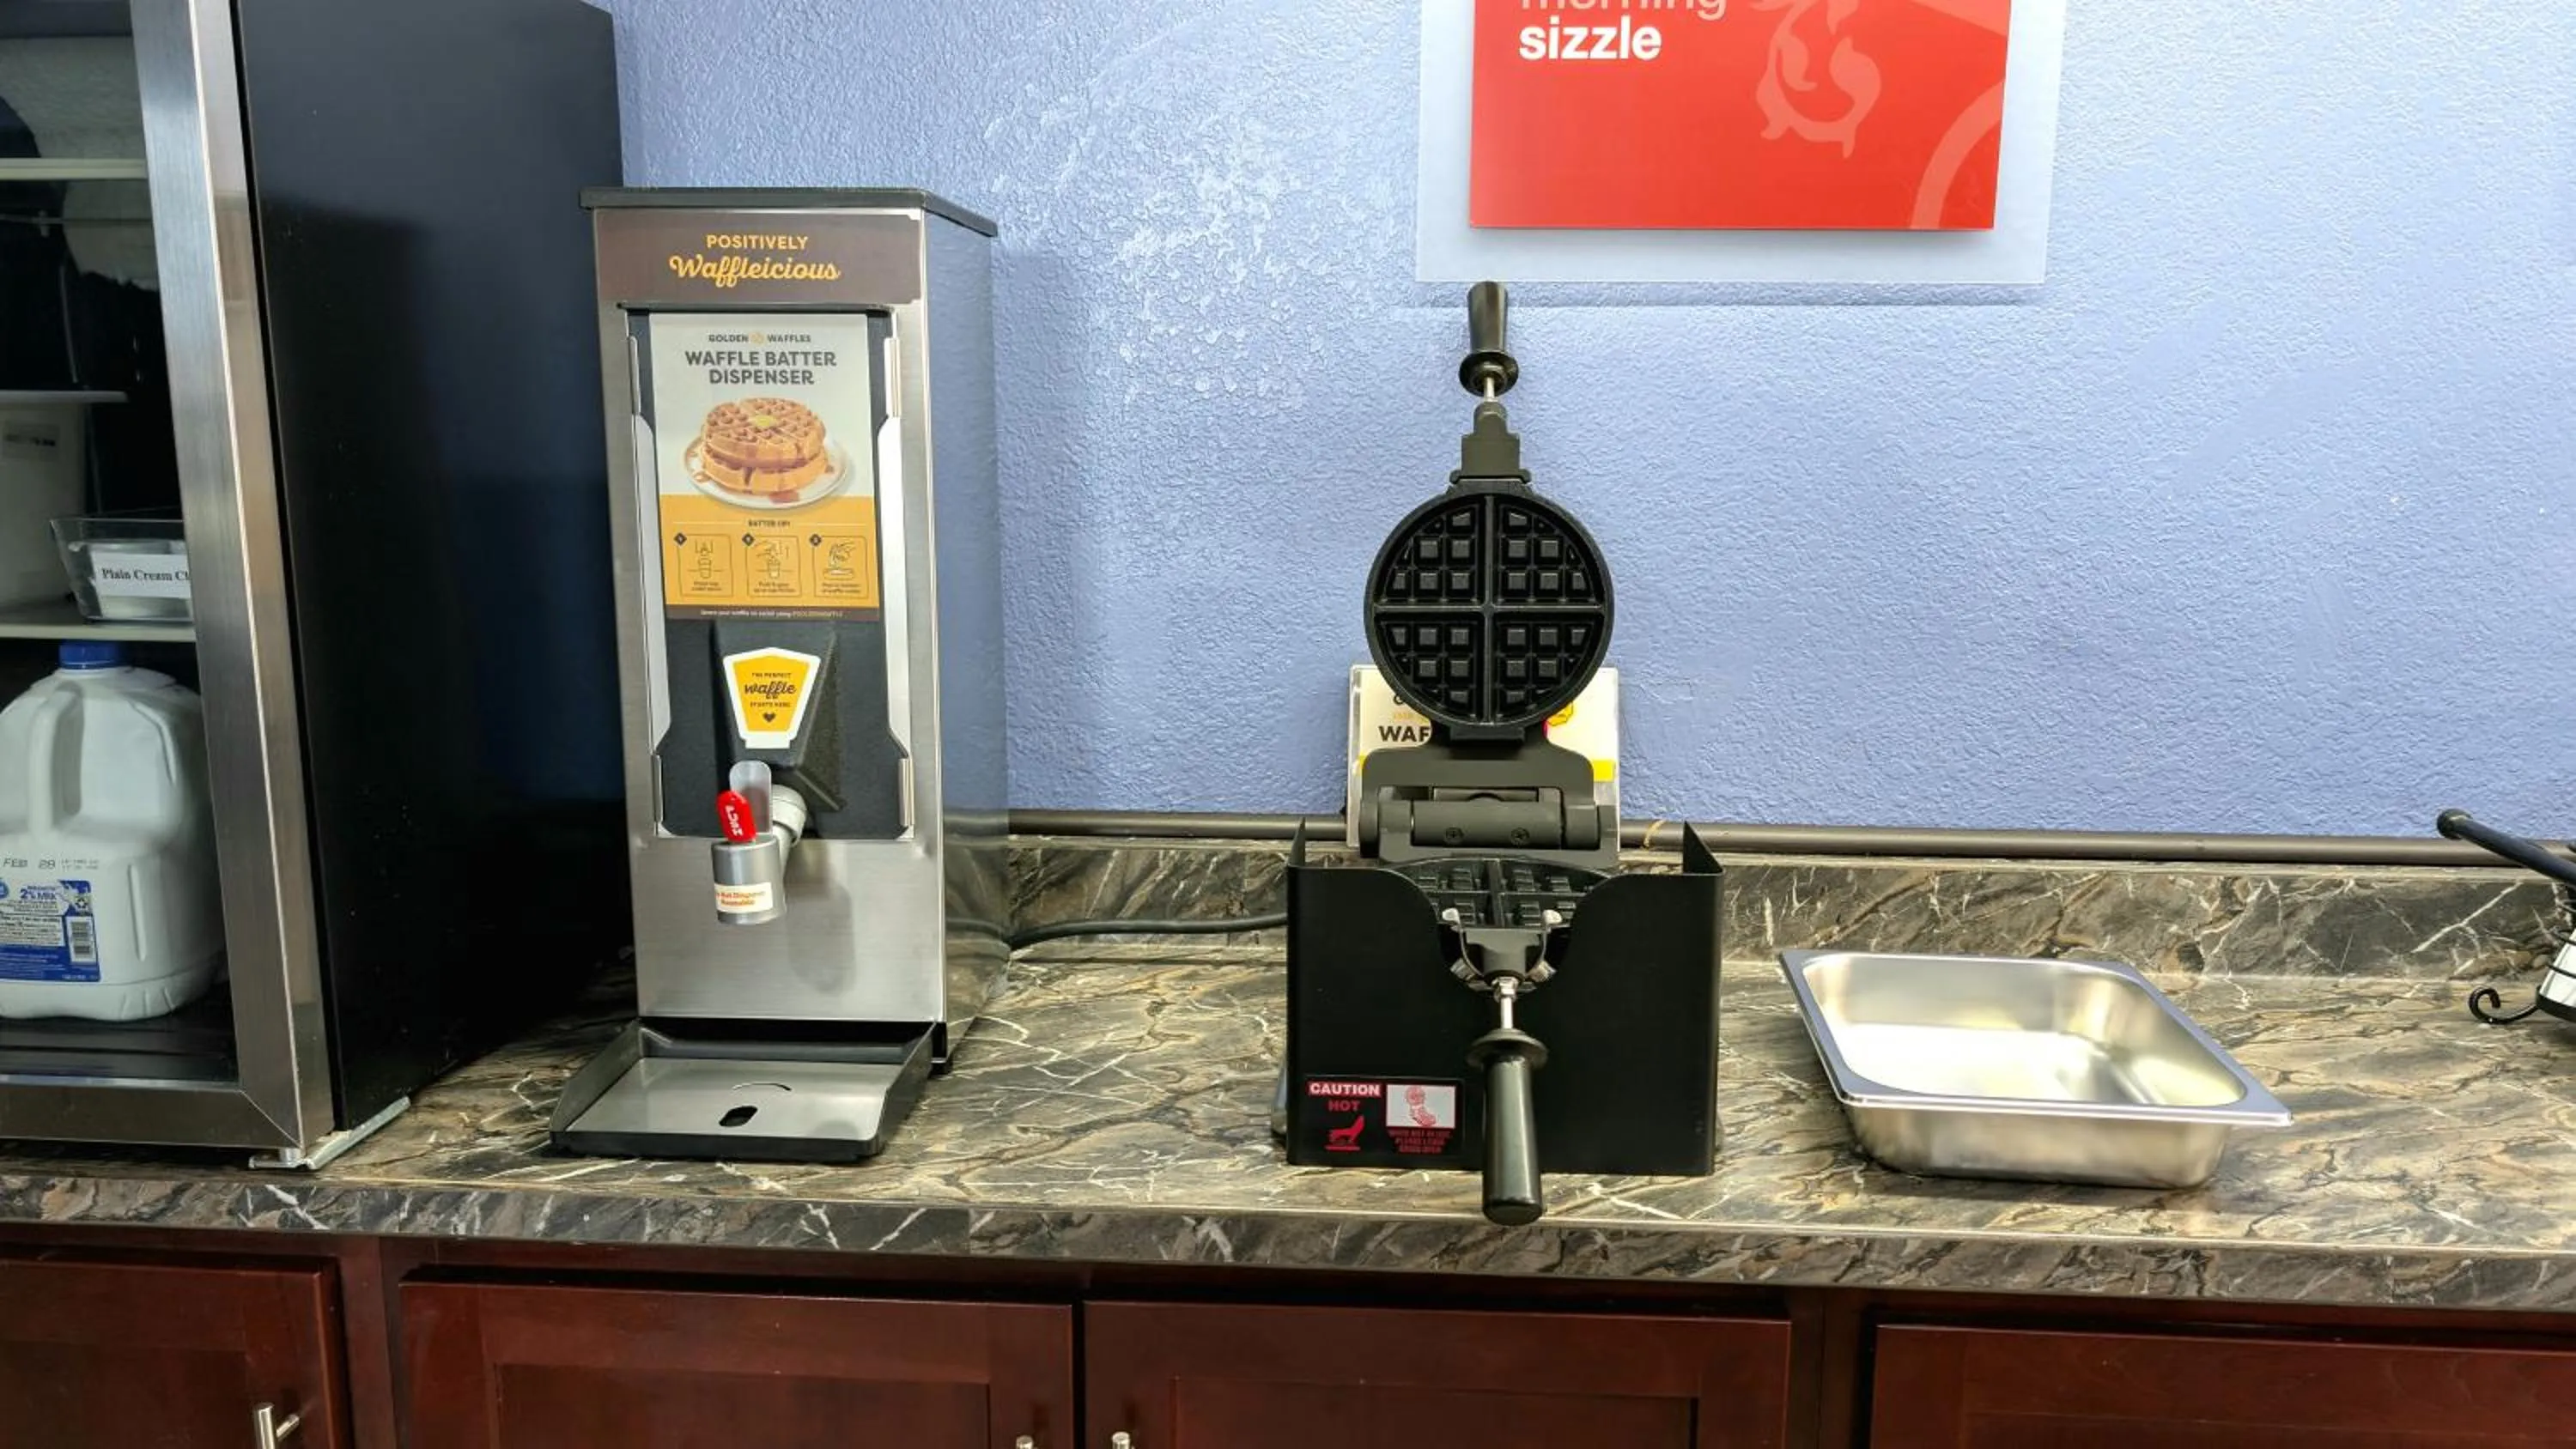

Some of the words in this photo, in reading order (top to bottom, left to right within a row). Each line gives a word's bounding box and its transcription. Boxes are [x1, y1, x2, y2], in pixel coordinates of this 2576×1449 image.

[1519, 15, 1662, 60] sizzle
[707, 234, 809, 250] POSITIVELY
[670, 254, 841, 288] Waffleicious
[708, 334, 749, 343] GOLDEN
[767, 334, 811, 343] WAFFLES
[685, 350, 760, 367] WAFFLE
[765, 350, 837, 367] BATTER
[709, 369, 815, 385] DISPENSER
[101, 568, 131, 579] Plain
[134, 569, 173, 580] Cream
[744, 681, 797, 700] waffle
[1378, 725, 1431, 743] WAF
[3, 858, 28, 868] FEB
[1309, 1083, 1380, 1096] CAUTION
[1328, 1100, 1360, 1112] HOT
